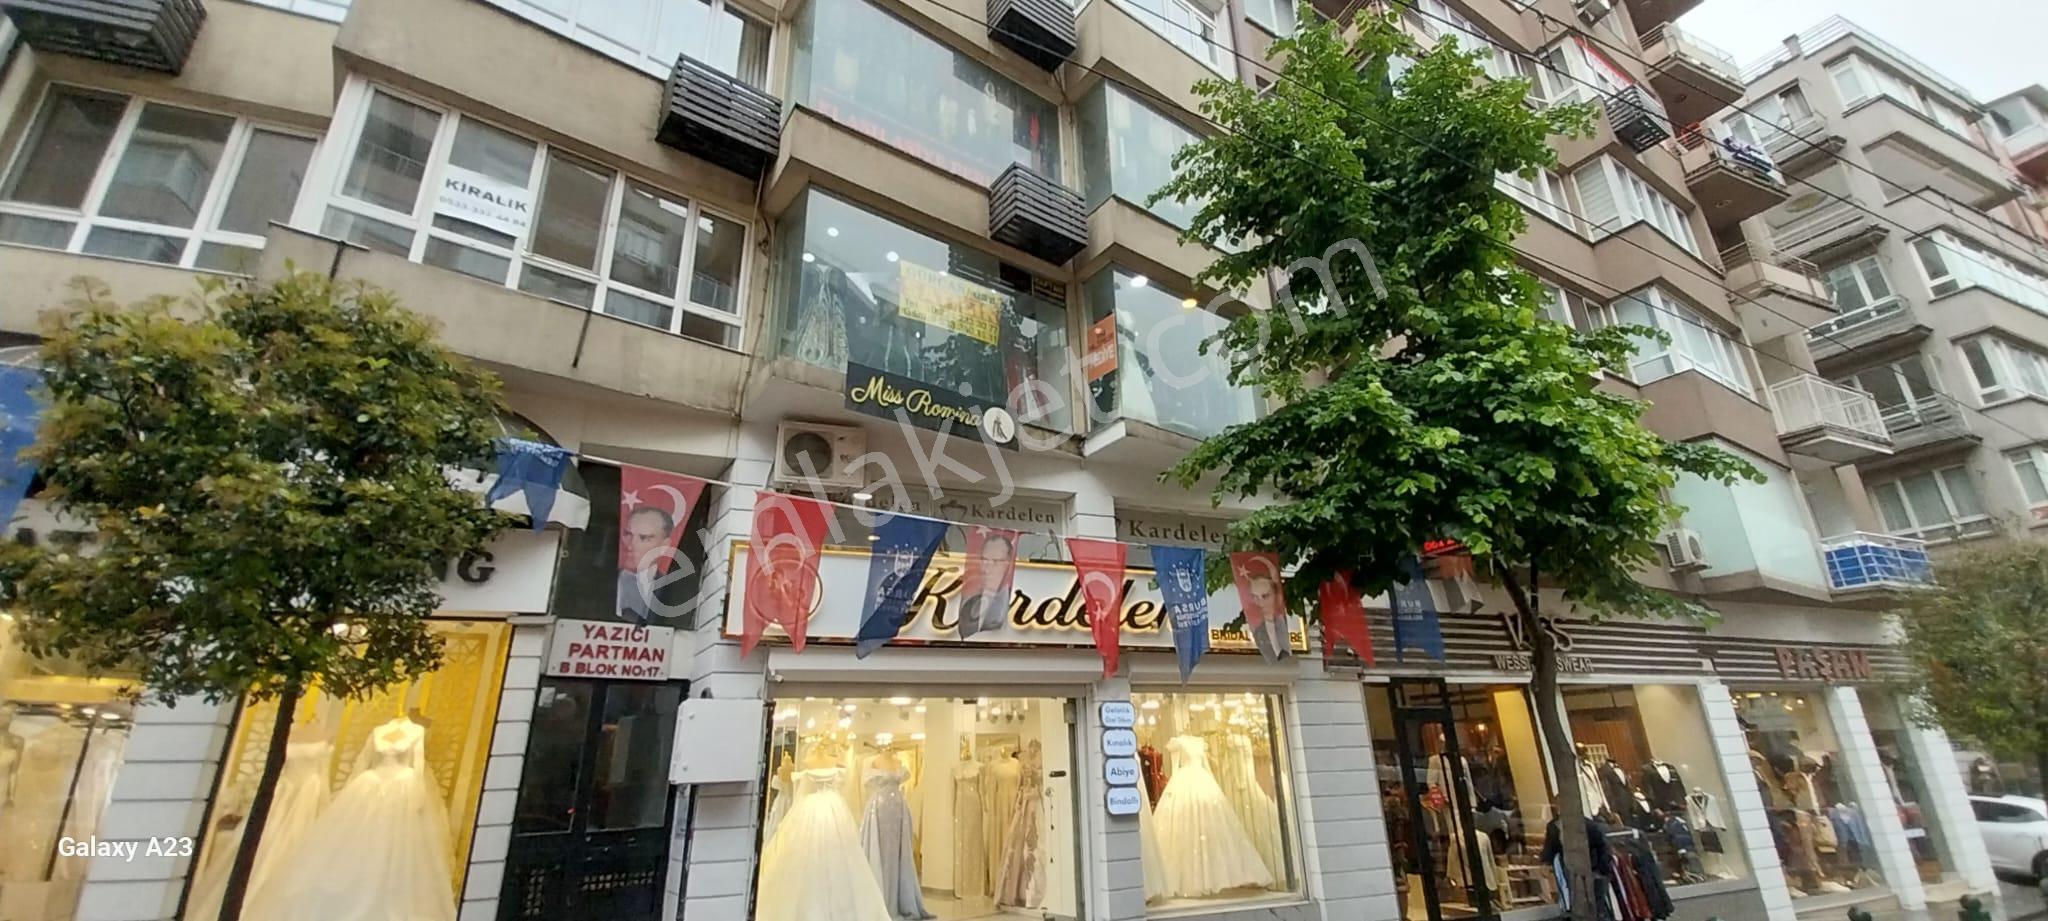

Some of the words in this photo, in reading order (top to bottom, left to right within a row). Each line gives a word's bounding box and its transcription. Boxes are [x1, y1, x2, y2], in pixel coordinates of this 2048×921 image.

[851, 376, 905, 406] Miss
[906, 389, 982, 426] Romina
[972, 503, 1056, 524] Kardelen
[898, 566, 1170, 632] Kardele
[568, 643, 665, 662] PARTMAN
[560, 662, 571, 673] B
[575, 662, 618, 676] BLOK
[1110, 767, 1136, 778] Abiye
